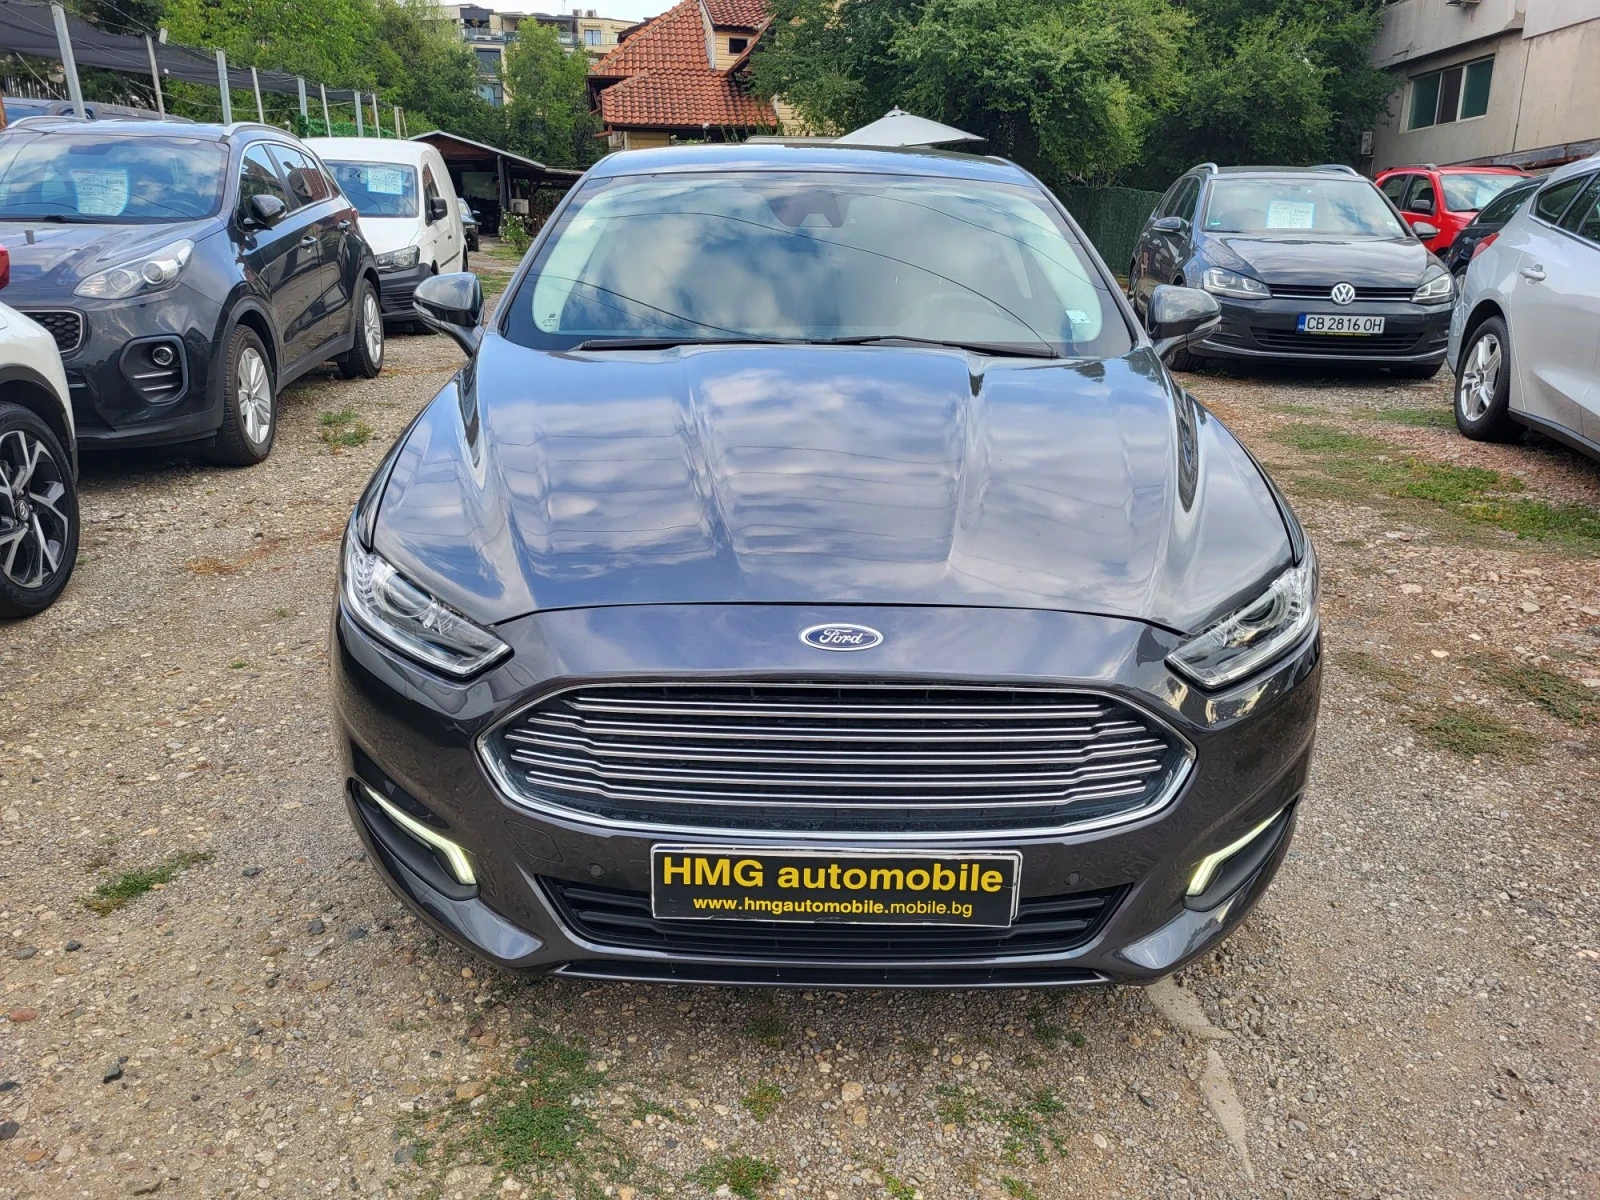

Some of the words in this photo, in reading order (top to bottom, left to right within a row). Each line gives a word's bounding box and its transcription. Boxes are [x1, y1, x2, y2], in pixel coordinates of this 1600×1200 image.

[1307, 317, 1325, 330] CB
[1327, 317, 1361, 331] 2816
[1363, 318, 1383, 332] OH
[819, 628, 864, 644] Ford
[663, 856, 764, 887] HMG
[777, 863, 1003, 892] automobile
[693, 896, 972, 918] www.hmgautomobile.mobile.bg
